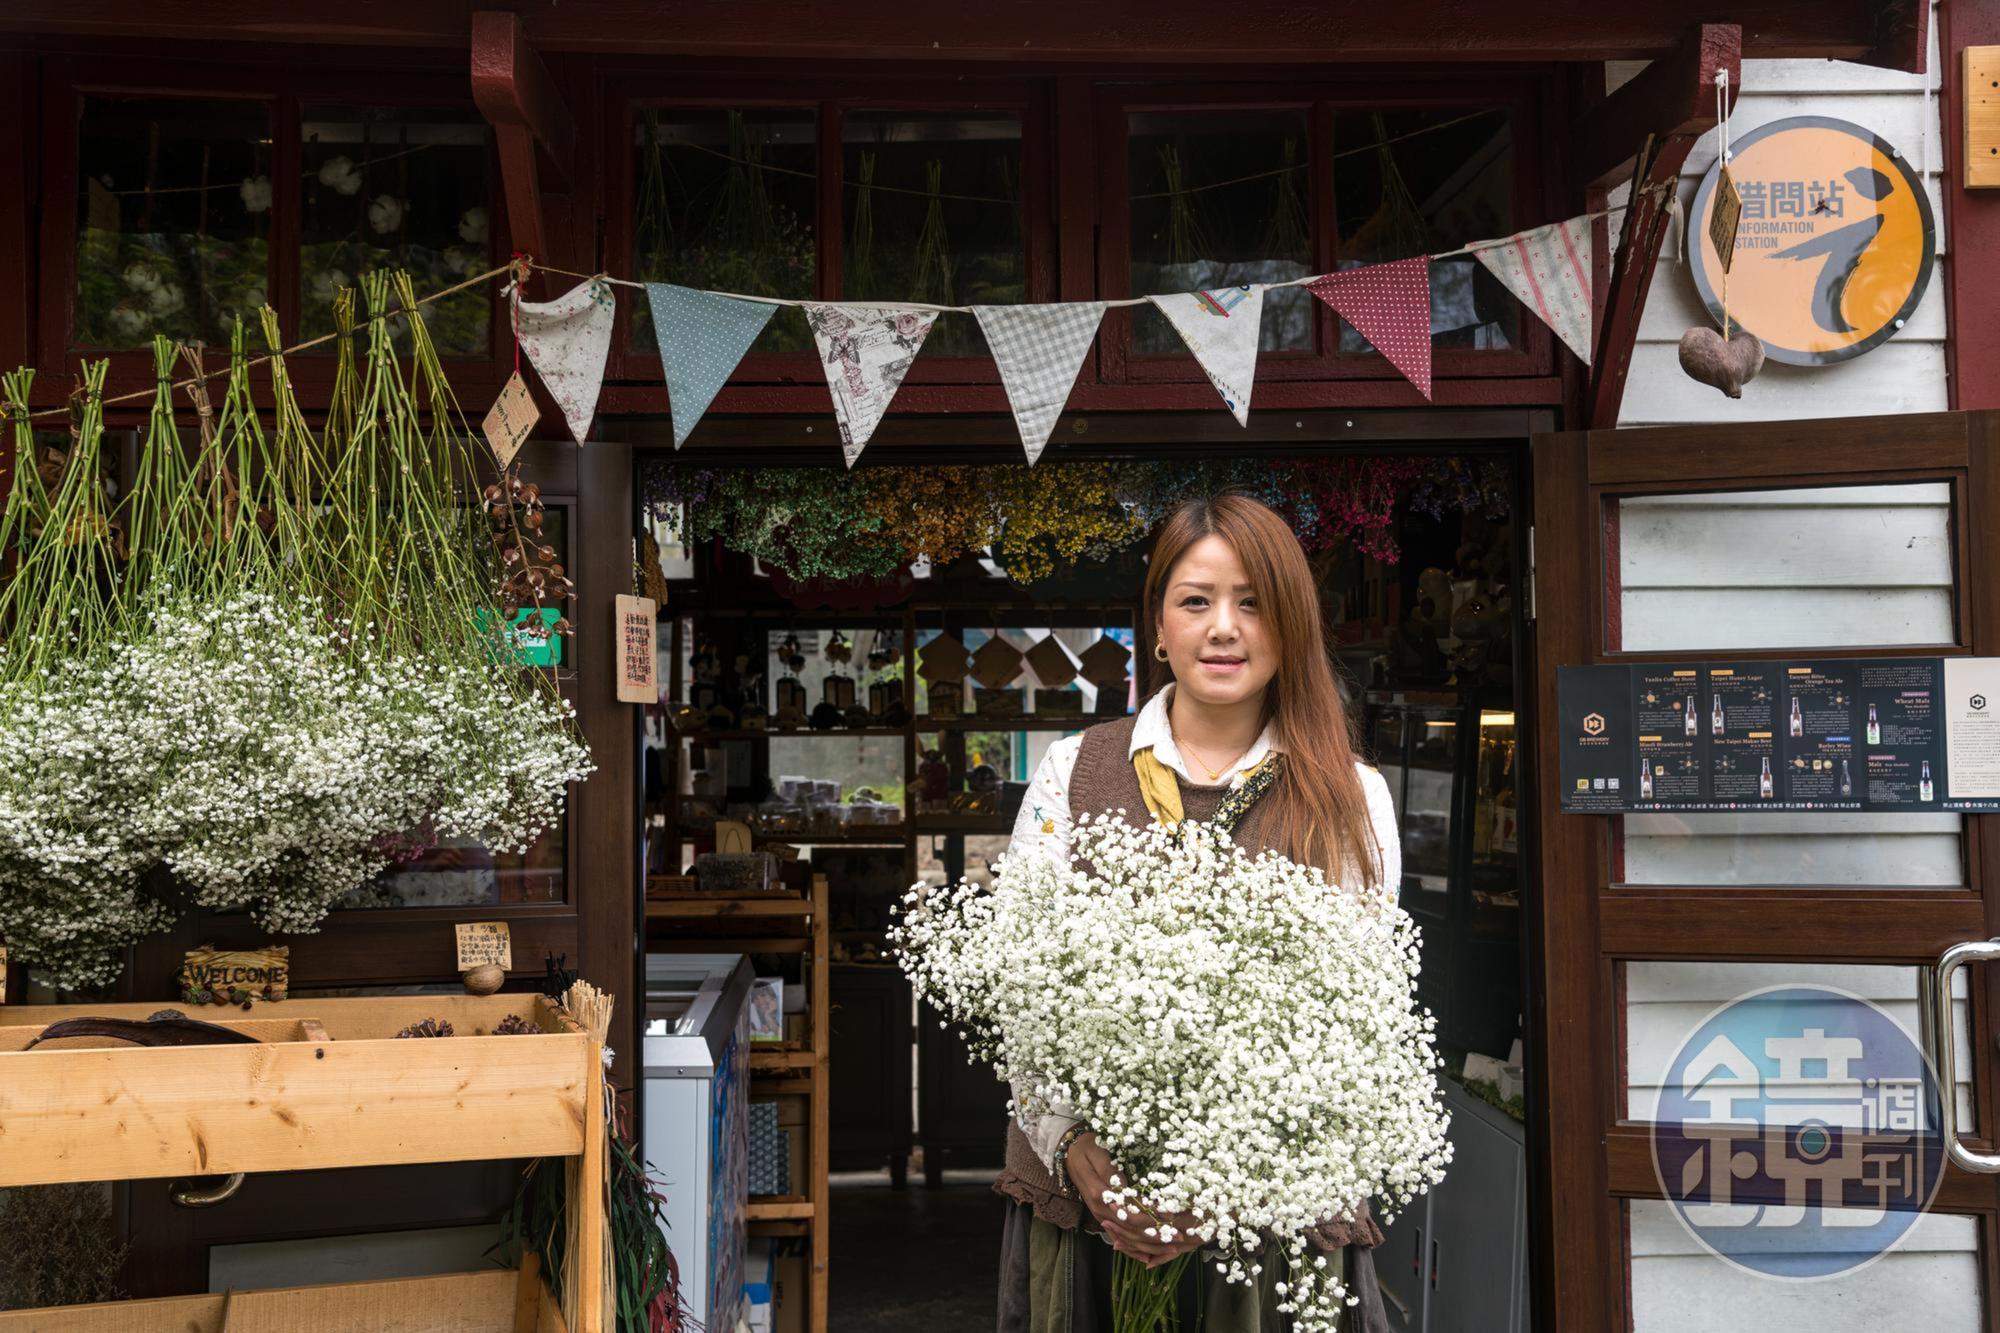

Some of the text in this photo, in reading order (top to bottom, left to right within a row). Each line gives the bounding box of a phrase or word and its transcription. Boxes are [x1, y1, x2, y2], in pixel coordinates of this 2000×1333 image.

[1735, 180, 1845, 219] 借問站
[1737, 221, 1814, 234] NFORMATION
[1734, 236, 1778, 249] STATION
[187, 962, 286, 985] WELCOME
